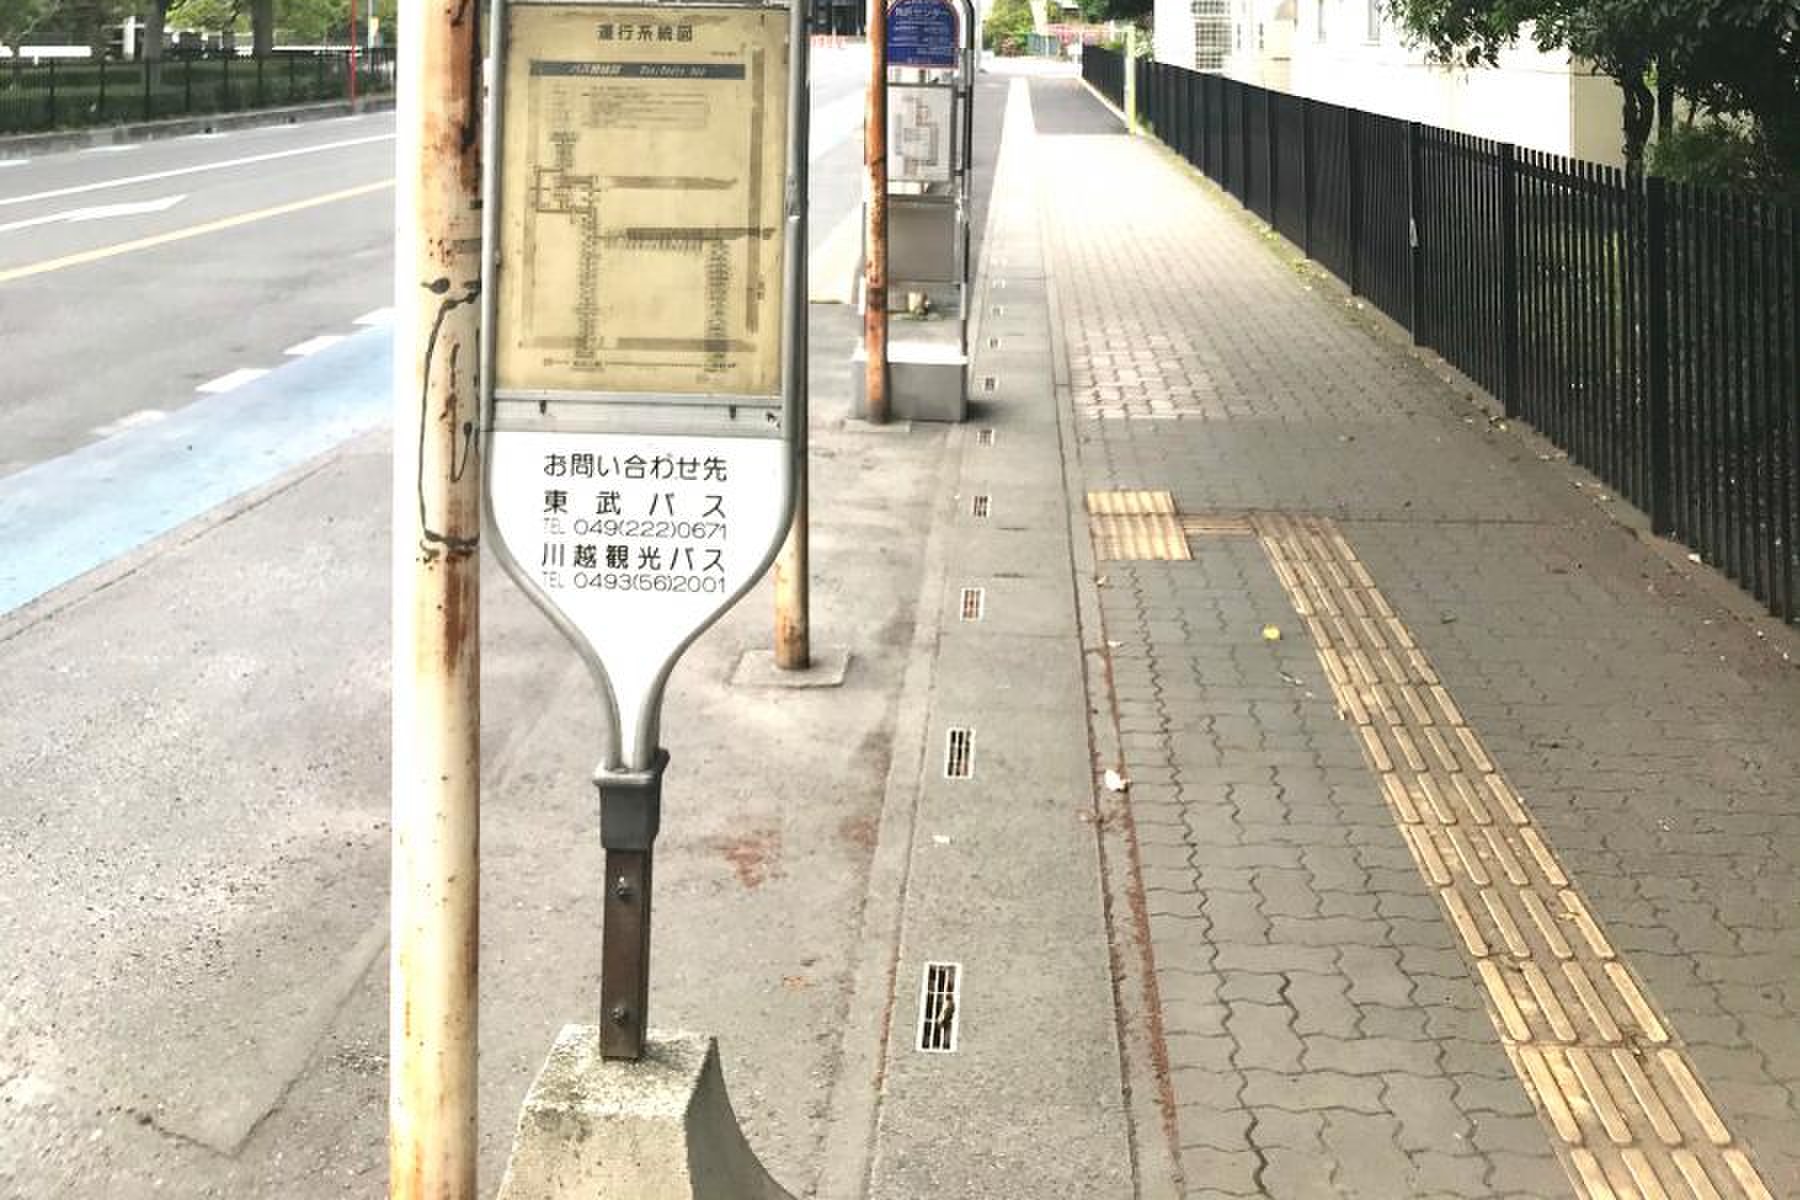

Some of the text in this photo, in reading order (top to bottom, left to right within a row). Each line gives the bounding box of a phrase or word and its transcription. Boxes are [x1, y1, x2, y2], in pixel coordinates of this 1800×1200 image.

[543, 453, 728, 482] お問い合わせ先
[544, 489, 726, 519] 東武バス
[574, 519, 727, 539] 049(222)0671
[542, 543, 725, 573] 川越観光バス
[574, 572, 725, 592] 0493(56)2001
